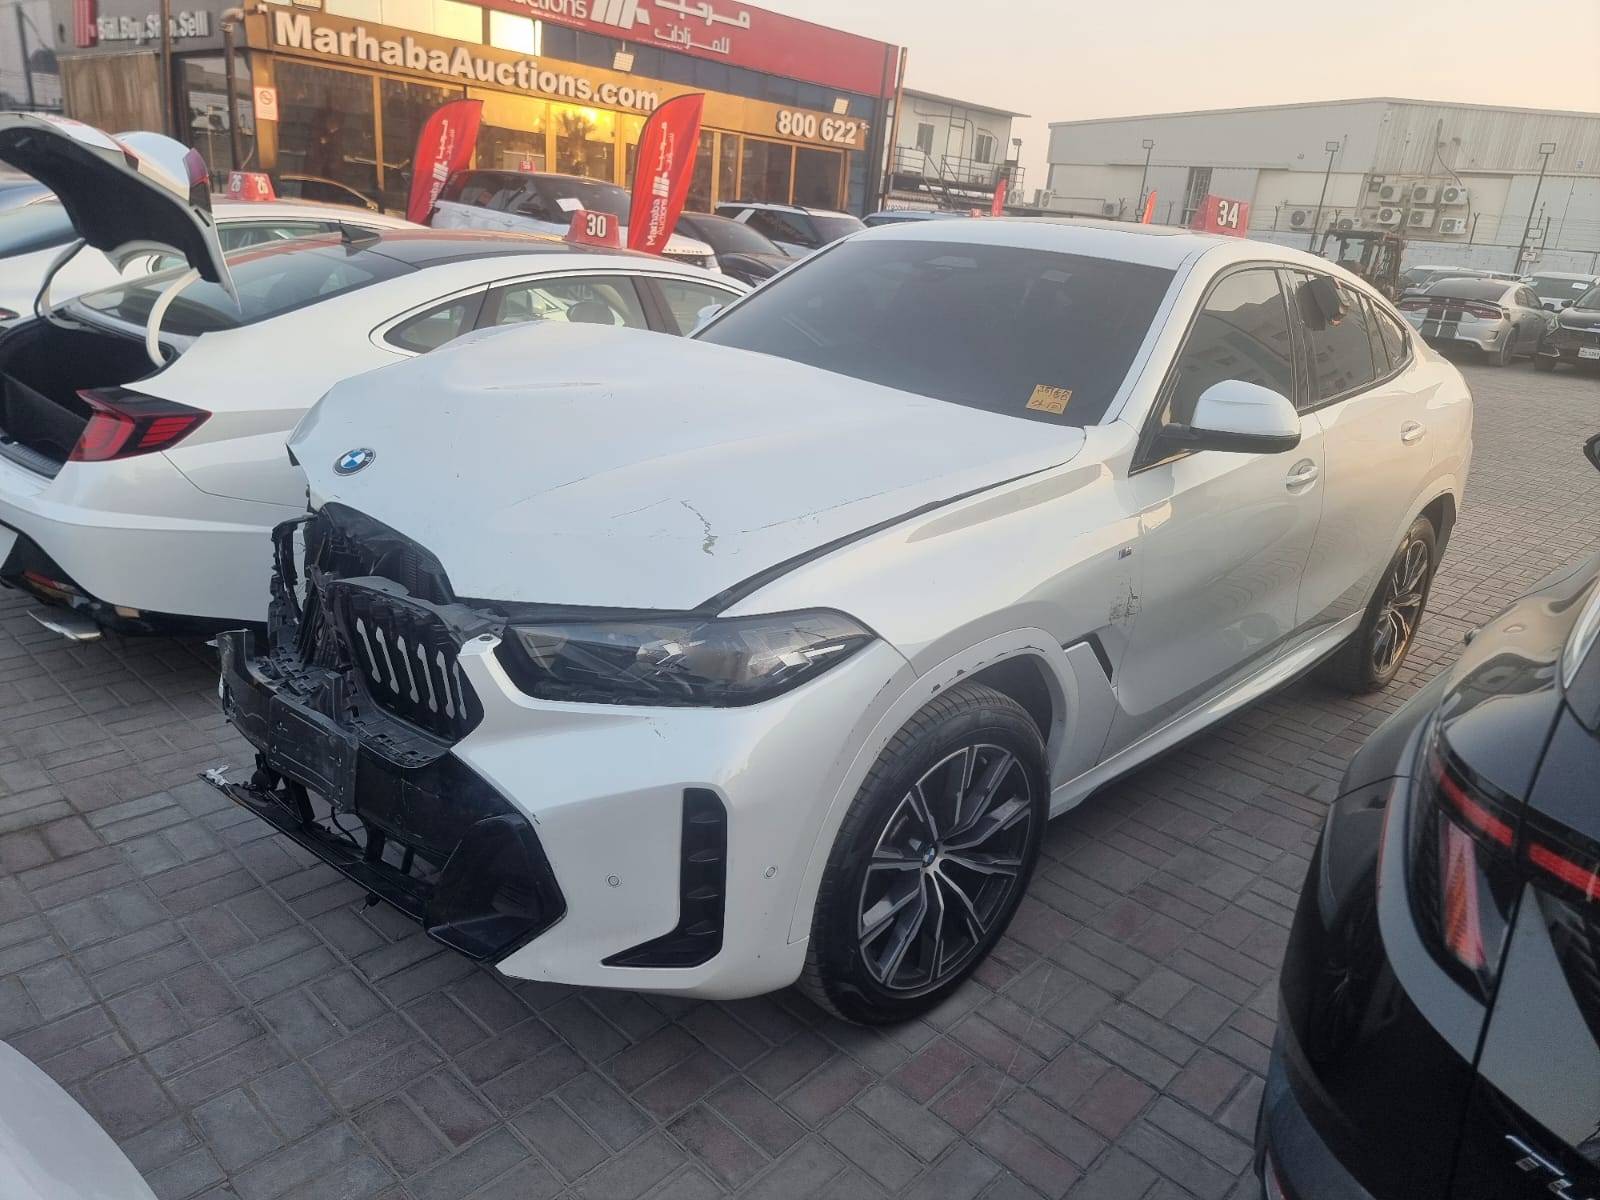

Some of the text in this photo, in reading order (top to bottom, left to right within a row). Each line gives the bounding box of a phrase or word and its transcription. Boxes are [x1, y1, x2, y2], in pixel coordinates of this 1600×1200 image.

[654, 23, 730, 54] للمزادات
[274, 11, 658, 110] MarhabaAuctions.com
[777, 109, 857, 145] 800 622
[586, 213, 607, 238] 30
[646, 198, 661, 246] Marhaba
[1217, 199, 1240, 229] 34
